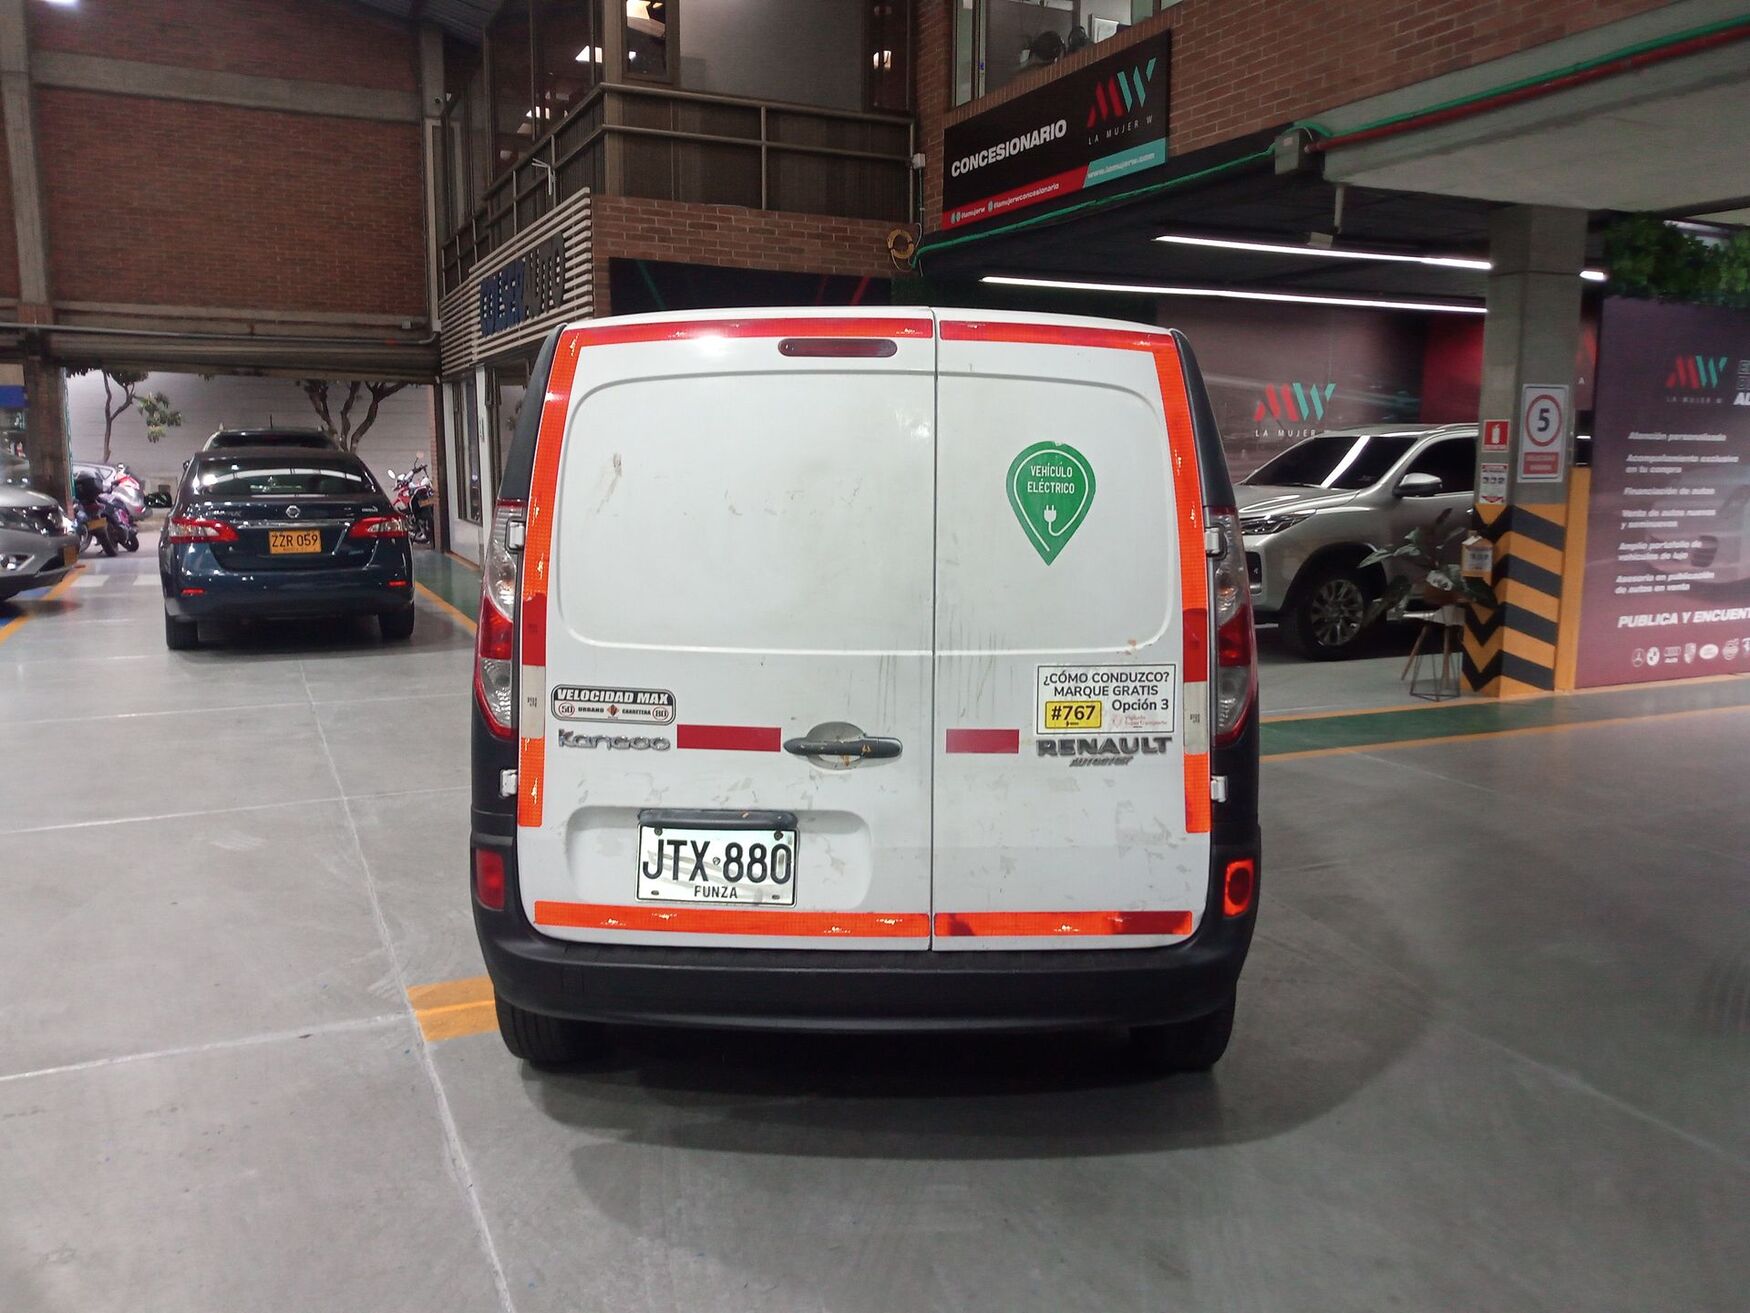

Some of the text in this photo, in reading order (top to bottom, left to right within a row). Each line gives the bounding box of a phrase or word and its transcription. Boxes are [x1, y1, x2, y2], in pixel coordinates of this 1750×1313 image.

[1088, 115, 1153, 146] LA MUJER W
[951, 119, 1067, 178] CONCESIONARIO
[1537, 407, 1550, 432] 5
[1255, 428, 1268, 437] LA
[1278, 428, 1317, 438] MUJER
[1031, 461, 1073, 478] VEHÍCULO
[1027, 478, 1075, 494] ELÉCTRICO
[272, 533, 318, 548] ZZR 059
[1617, 612, 1678, 628] PUBLICA
[1682, 611, 1692, 624] Y
[1043, 670, 1170, 686] ¿CÓMO CONDUZCO?
[557, 688, 669, 705] VELOCIDAD MAX
[1054, 685, 1158, 698] MARQUE GRATIS
[561, 704, 573, 714] 50
[622, 708, 651, 716] CARRETERA
[655, 709, 667, 718] 80
[1051, 705, 1096, 721] #767
[1111, 698, 1169, 713] Opción 3
[558, 728, 671, 752] Kangoo
[1035, 737, 1172, 757] RENAULT
[642, 838, 792, 885] JTX 880
[694, 885, 738, 899] FUNZA
